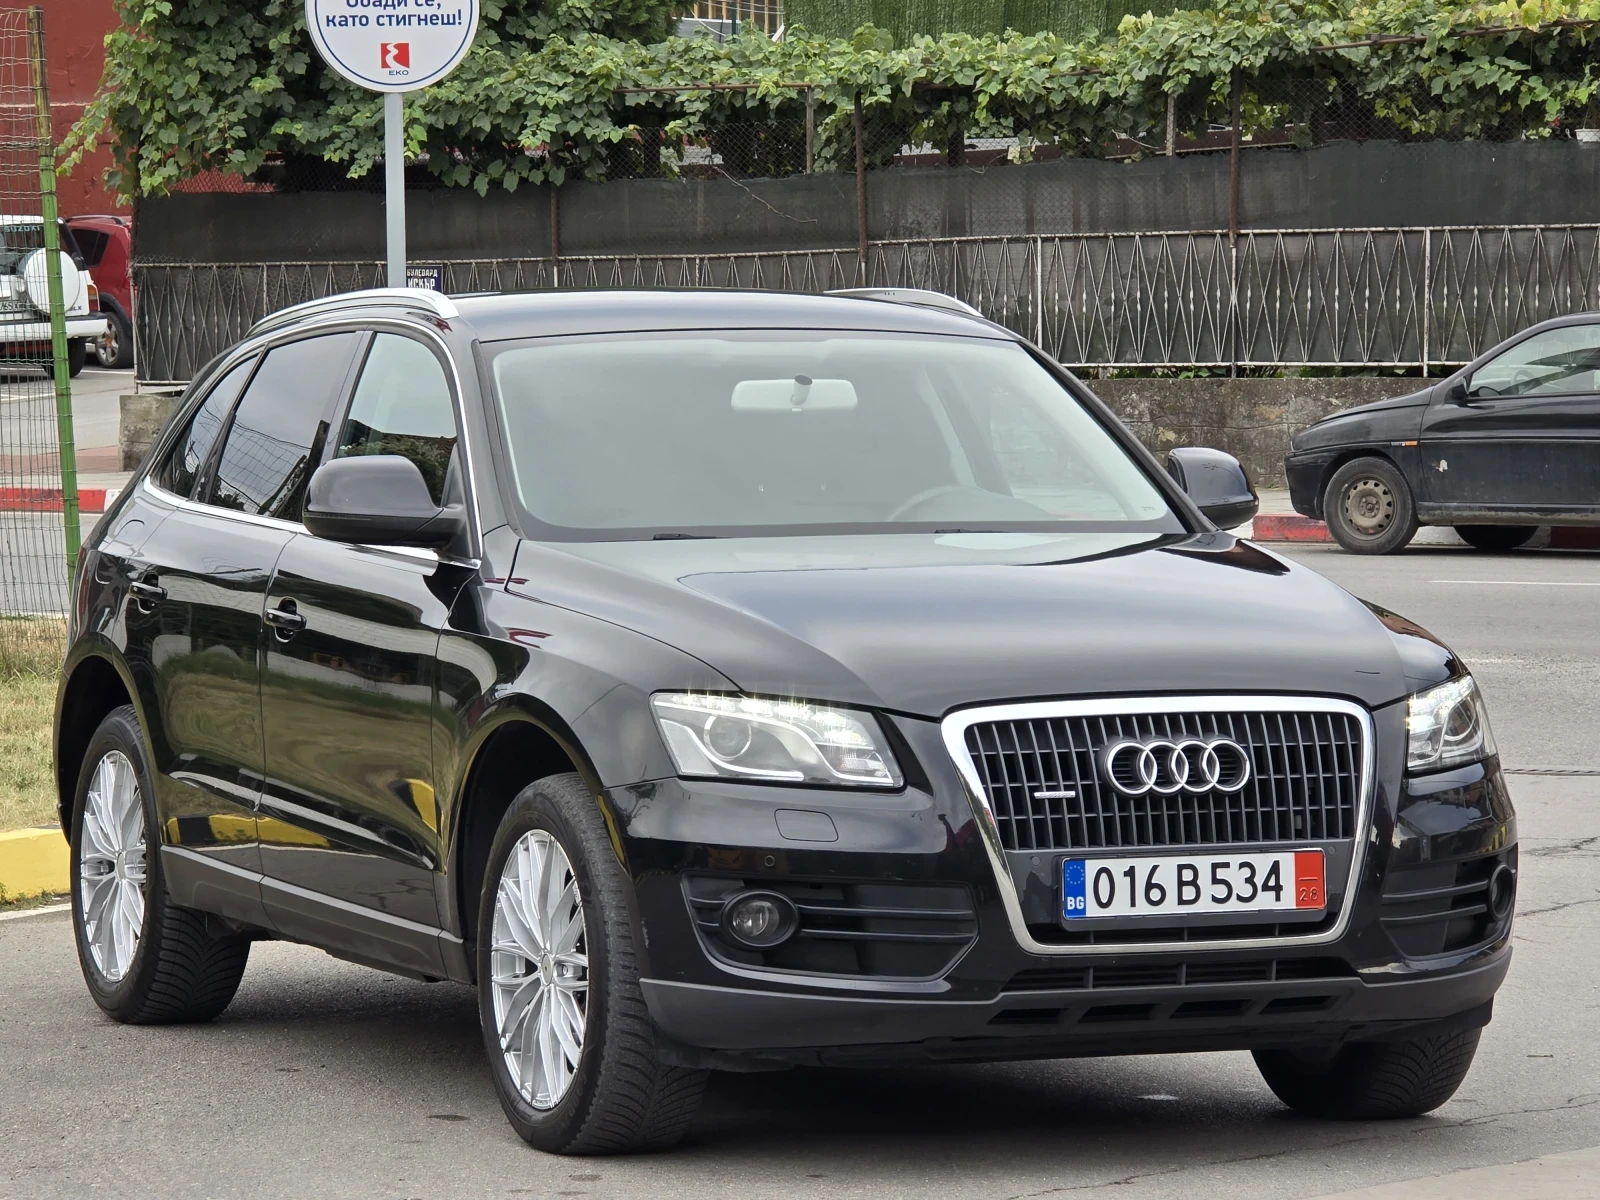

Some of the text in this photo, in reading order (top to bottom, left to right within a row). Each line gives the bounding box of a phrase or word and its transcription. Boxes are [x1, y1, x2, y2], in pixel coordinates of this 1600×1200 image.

[326, 9, 462, 27] като стигнеш!
[406, 268, 438, 278] БУЛЕВАРД
[1299, 886, 1319, 901] 28
[1067, 896, 1085, 910] BG
